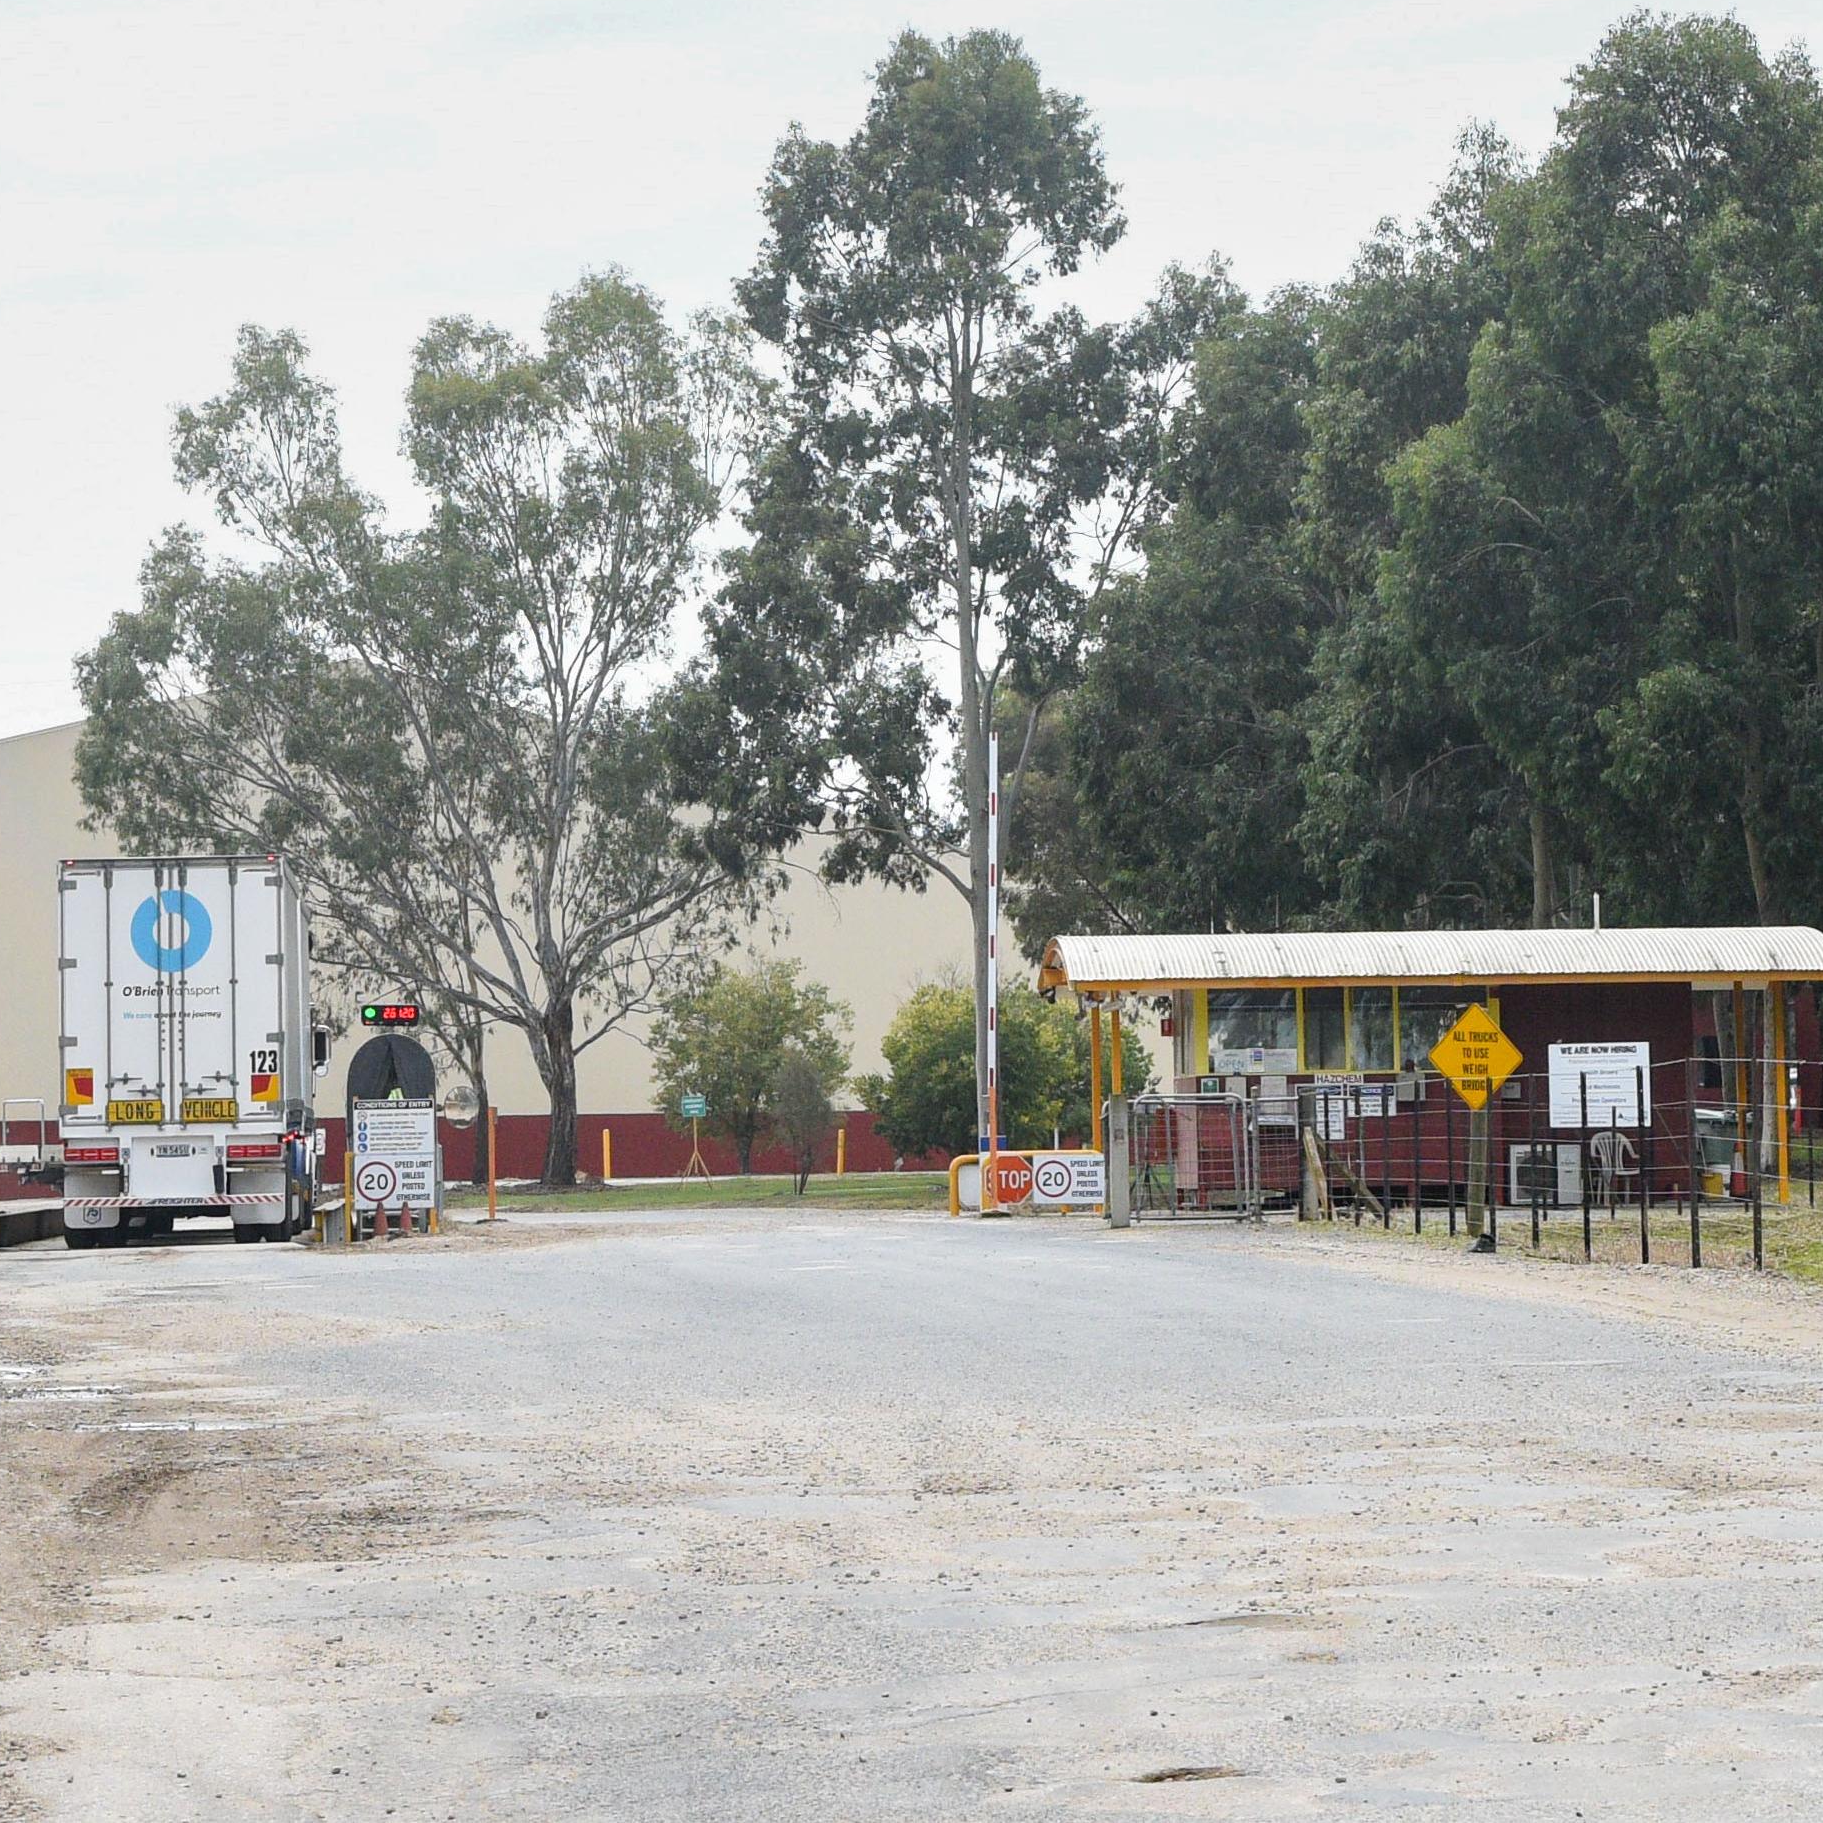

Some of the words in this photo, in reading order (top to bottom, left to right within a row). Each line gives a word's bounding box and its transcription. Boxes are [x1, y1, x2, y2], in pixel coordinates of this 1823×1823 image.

[122, 986, 163, 997] O'Brien
[166, 985, 221, 998] Transport
[1453, 1032, 1466, 1042] ALL
[1469, 1032, 1498, 1043] TRUCKS
[1462, 1048, 1472, 1058] TO
[1474, 1048, 1489, 1058] USE
[1574, 1046, 1589, 1054] ARE
[250, 1050, 277, 1073] 123
[1462, 1064, 1488, 1074] WEIGH
[116, 1102, 154, 1120] LONG
[184, 1100, 235, 1118] VEHICLE
[364, 1174, 388, 1190] 20
[1042, 1171, 1065, 1186] 20
